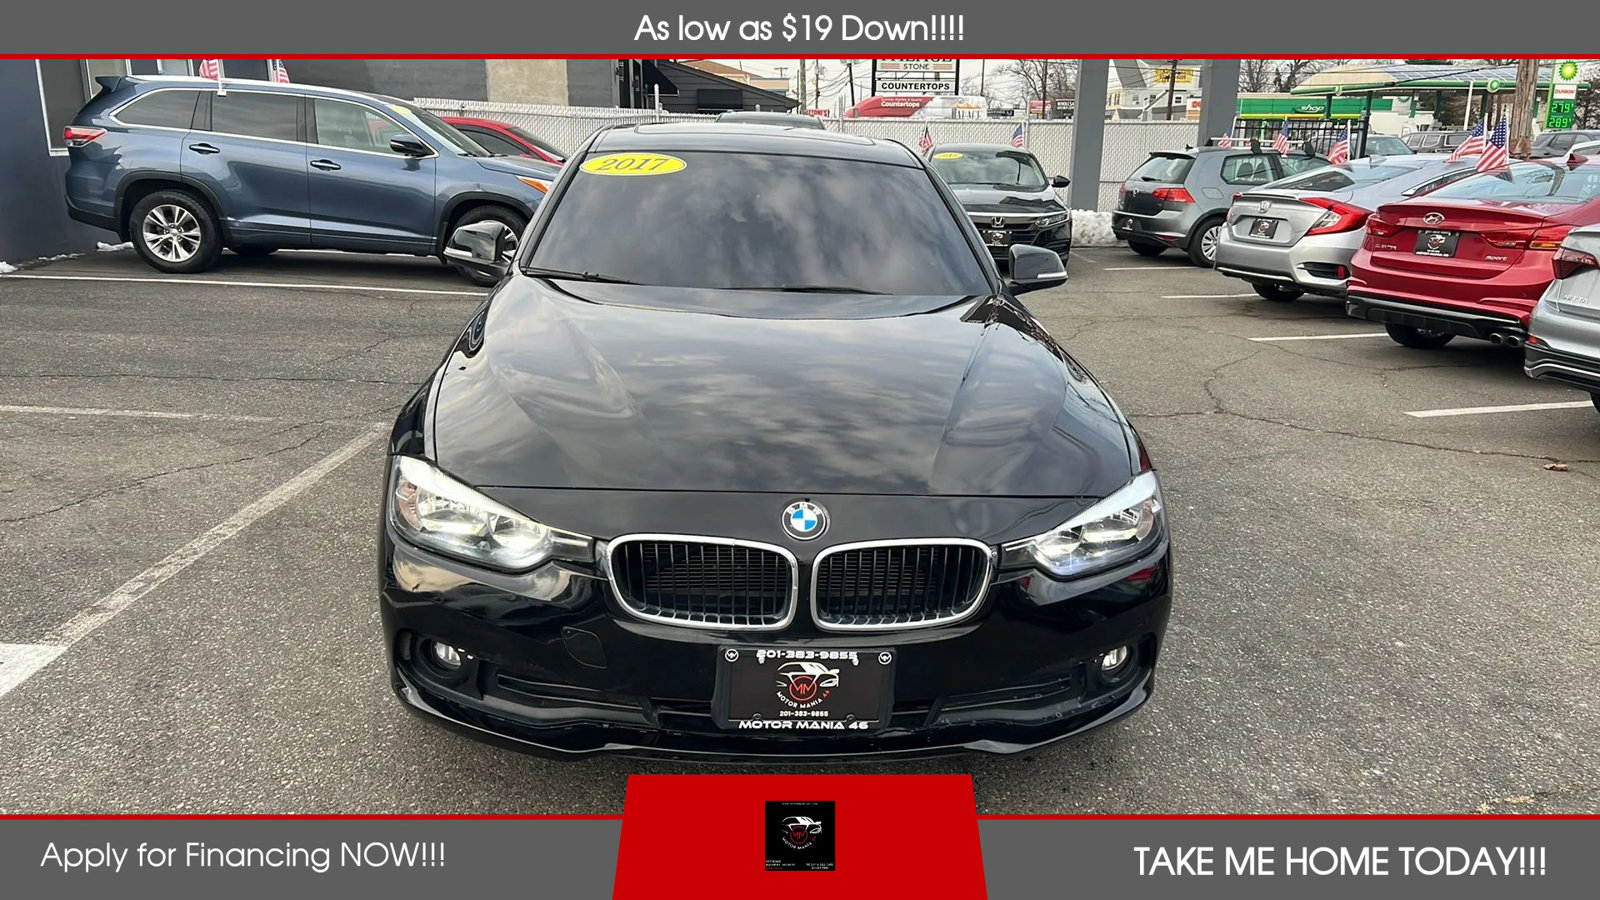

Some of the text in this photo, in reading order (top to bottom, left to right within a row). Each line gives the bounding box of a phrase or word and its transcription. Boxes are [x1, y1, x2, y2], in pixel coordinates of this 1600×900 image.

[881, 82, 950, 91] COUNTERTOPS
[1301, 103, 1325, 112] shop
[595, 157, 670, 171] 2017
[756, 649, 859, 661] 201-383-9855
[775, 691, 799, 709] MOTOR
[799, 697, 823, 709] MANIA
[738, 720, 869, 730] MOTOR MANIA 46
